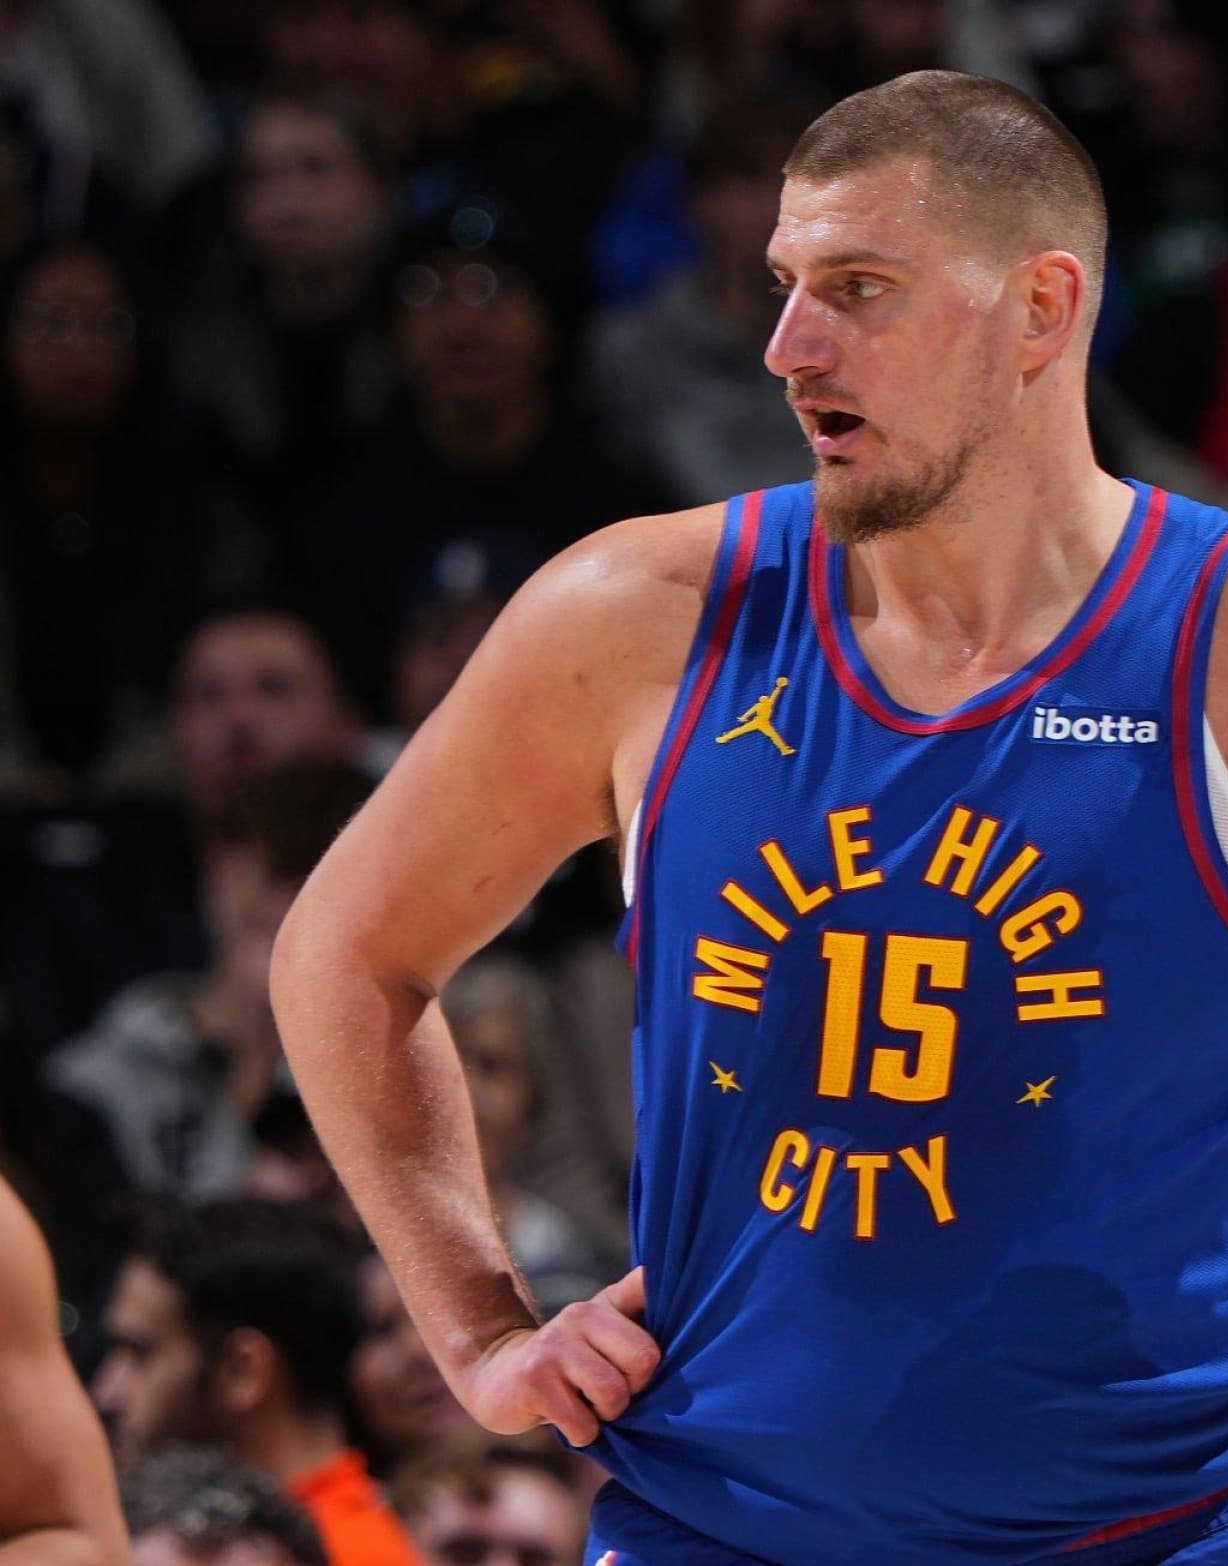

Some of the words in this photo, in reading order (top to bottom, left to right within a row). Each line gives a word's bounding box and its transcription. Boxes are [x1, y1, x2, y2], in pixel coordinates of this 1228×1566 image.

[1032, 706, 1159, 744] ibotta
[692, 803, 883, 1013] MILE
[922, 803, 1105, 1023] HIGH
[816, 928, 970, 1103] 15
[758, 1126, 956, 1240] CITY
